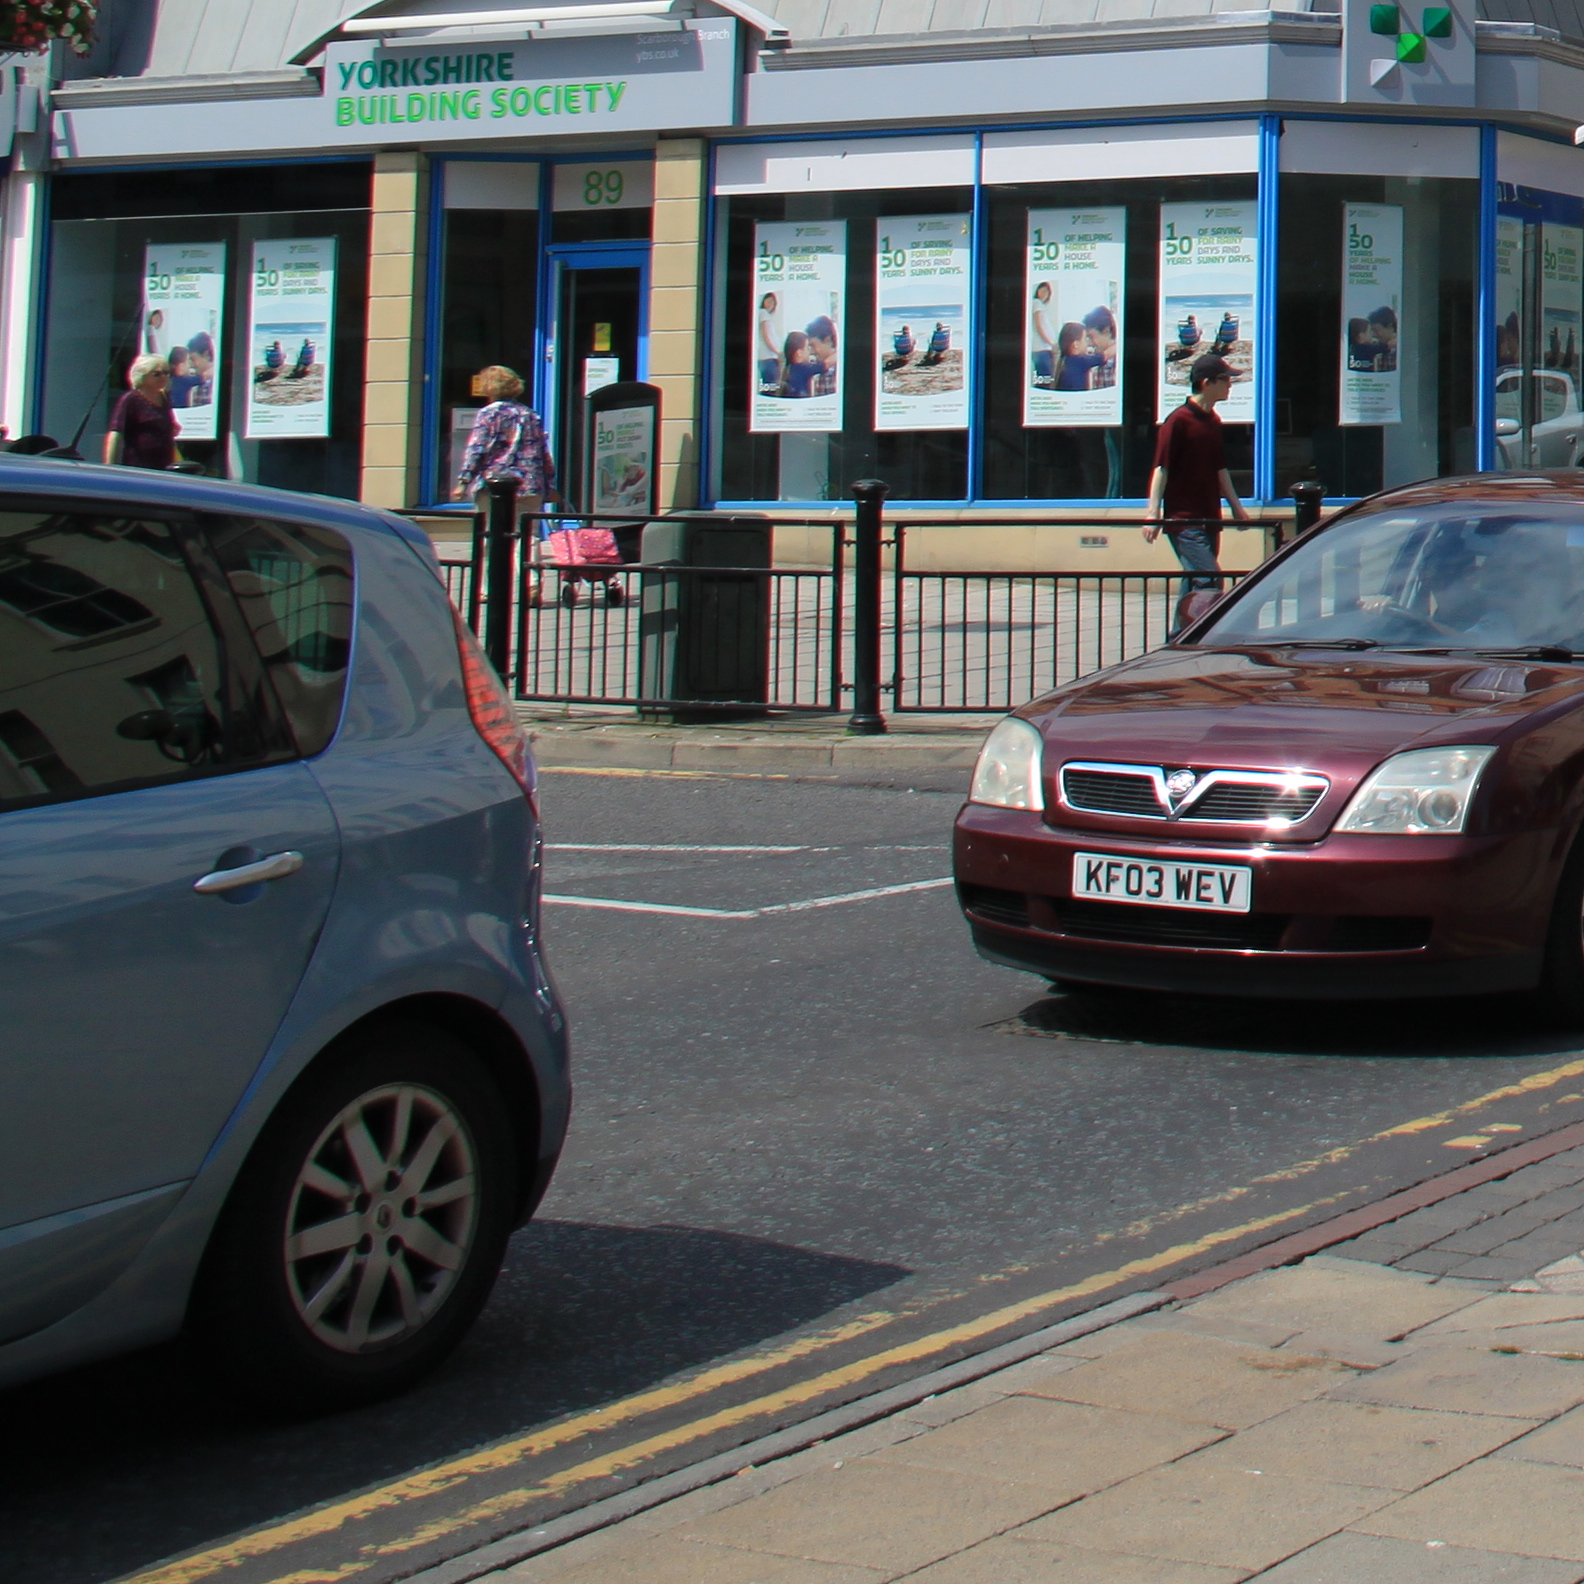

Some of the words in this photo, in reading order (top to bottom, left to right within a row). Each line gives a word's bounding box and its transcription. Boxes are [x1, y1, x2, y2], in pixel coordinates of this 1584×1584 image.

[636, 30, 696, 46] Scarborough
[698, 27, 730, 41] Branch
[636, 48, 680, 63] ybs.co.uk
[339, 51, 515, 91] YORKSHIRE
[336, 90, 482, 127] BUILDING
[492, 81, 627, 119] SOCIETY
[583, 169, 623, 206] 89
[1064, 234, 1076, 242] OF
[1077, 233, 1112, 242] HELPING
[1198, 228, 1209, 236] OF
[1211, 227, 1242, 235] SAVING
[789, 246, 800, 254] OF
[801, 245, 833, 254] HELPING
[911, 241, 921, 249] OF
[923, 240, 953, 248] SAVING
[1166, 236, 1193, 255] 50
[1349, 235, 1373, 249] 50
[882, 249, 907, 268] 50
[1033, 242, 1060, 261] 50
[1064, 252, 1092, 260] HOUSE
[759, 254, 784, 272] 50
[1197, 256, 1226, 264] SUNNY
[789, 264, 814, 272] HOUSE
[910, 268, 938, 276] SUNNY
[1085, 857, 1165, 900] KF03
[1175, 867, 1237, 906] WEV
